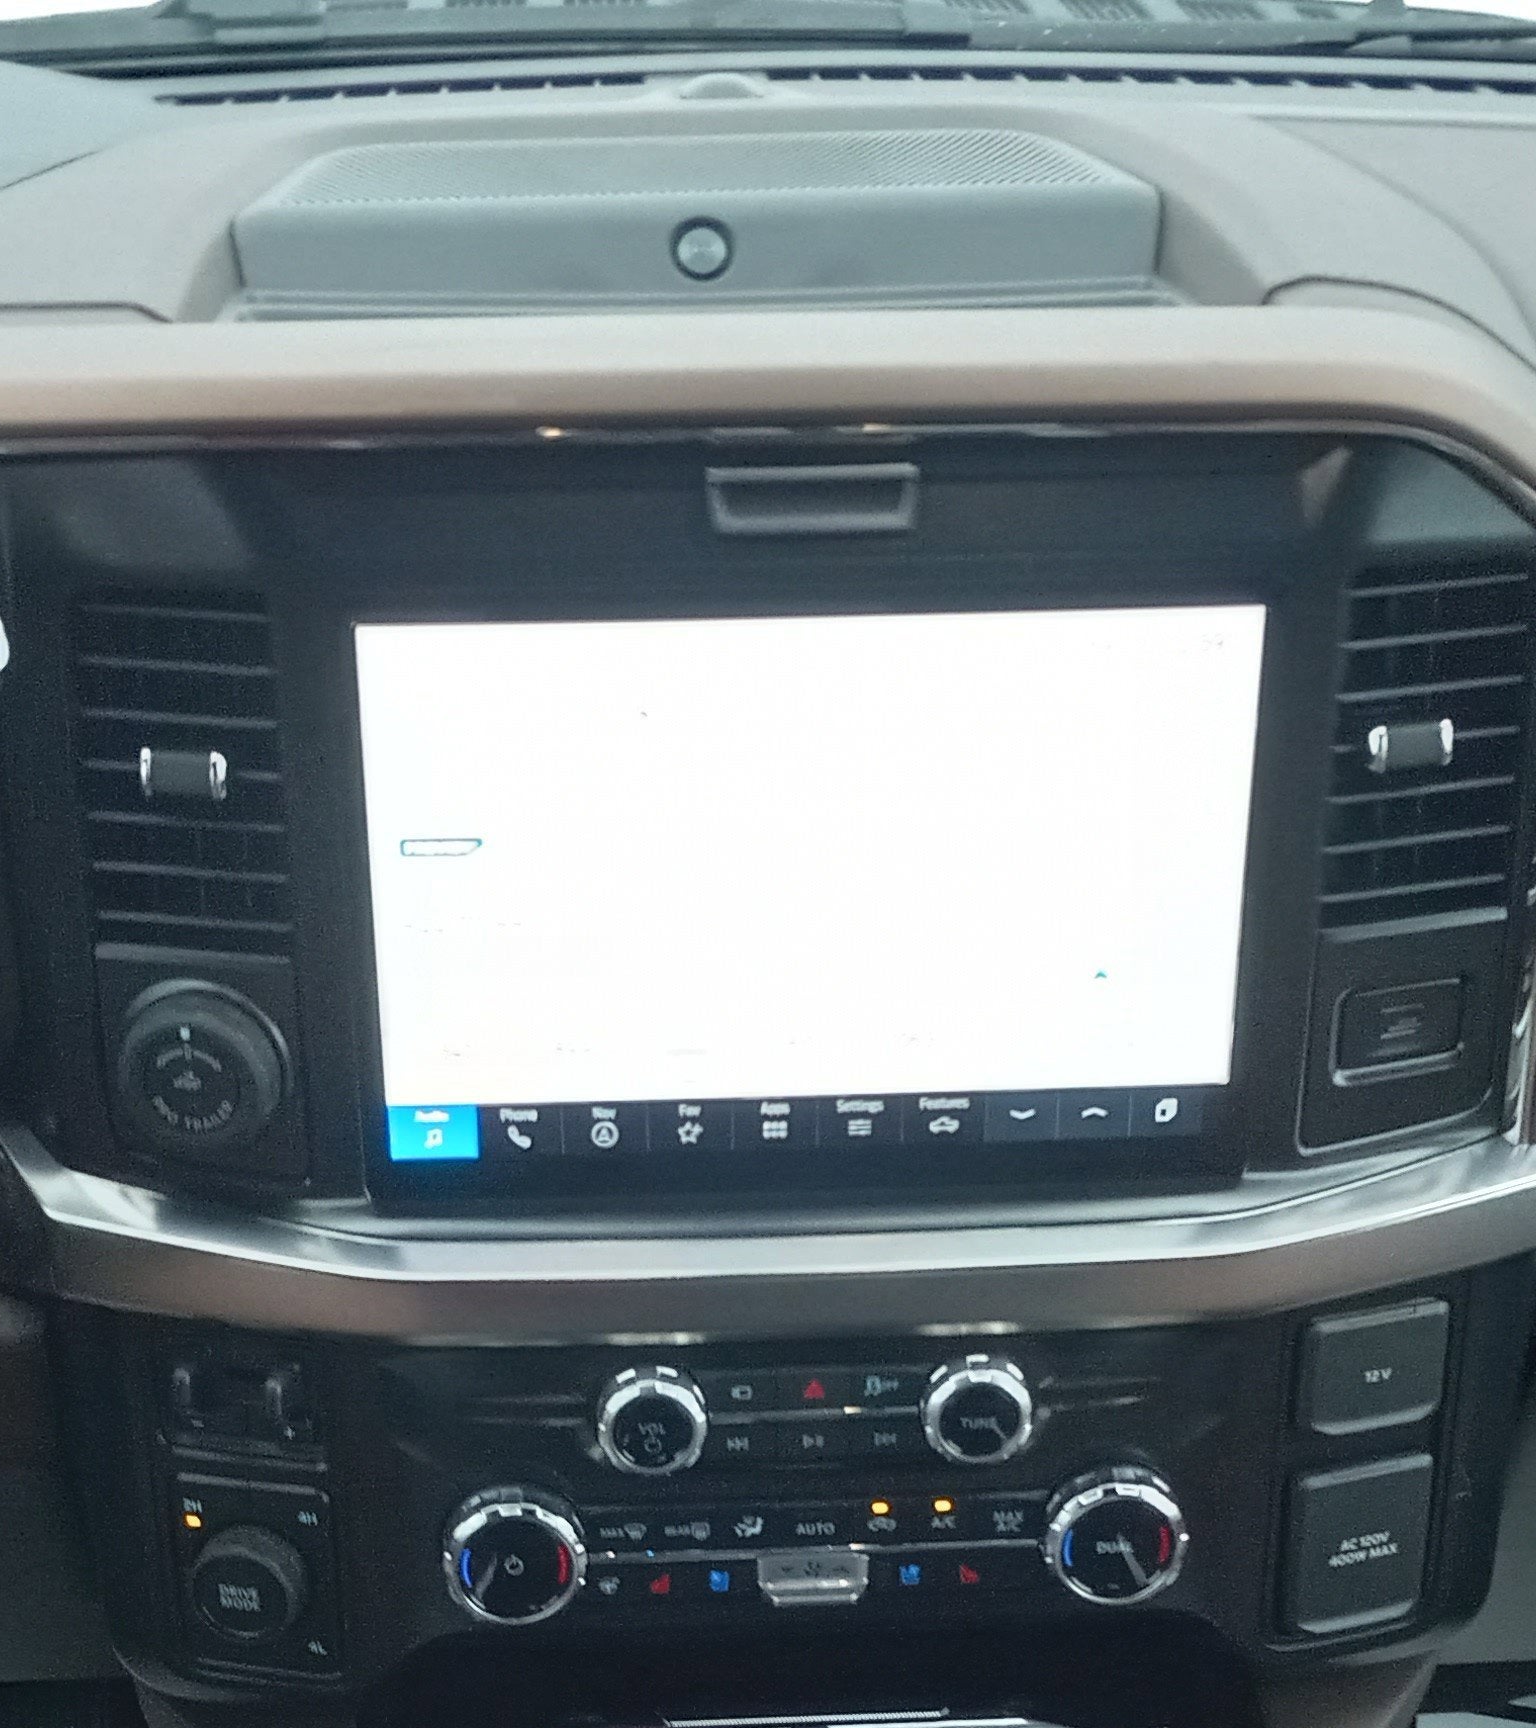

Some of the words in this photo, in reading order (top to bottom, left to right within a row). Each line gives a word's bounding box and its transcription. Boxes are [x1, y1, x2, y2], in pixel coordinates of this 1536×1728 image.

[678, 1103, 702, 1117] Fav
[761, 1101, 790, 1117] Apps
[836, 1099, 884, 1114] Settings
[919, 1097, 970, 1111] Features
[499, 1107, 538, 1123] Phone
[591, 1106, 617, 1120] Nav
[960, 1415, 998, 1429] TUNE
[931, 1516, 956, 1529] A/C
[992, 1509, 1024, 1522] MAX
[795, 1521, 836, 1536] AUTO
[1368, 1542, 1398, 1559] MAX
[218, 1583, 259, 1601] DRIVE
[220, 1596, 261, 1612] MODE
